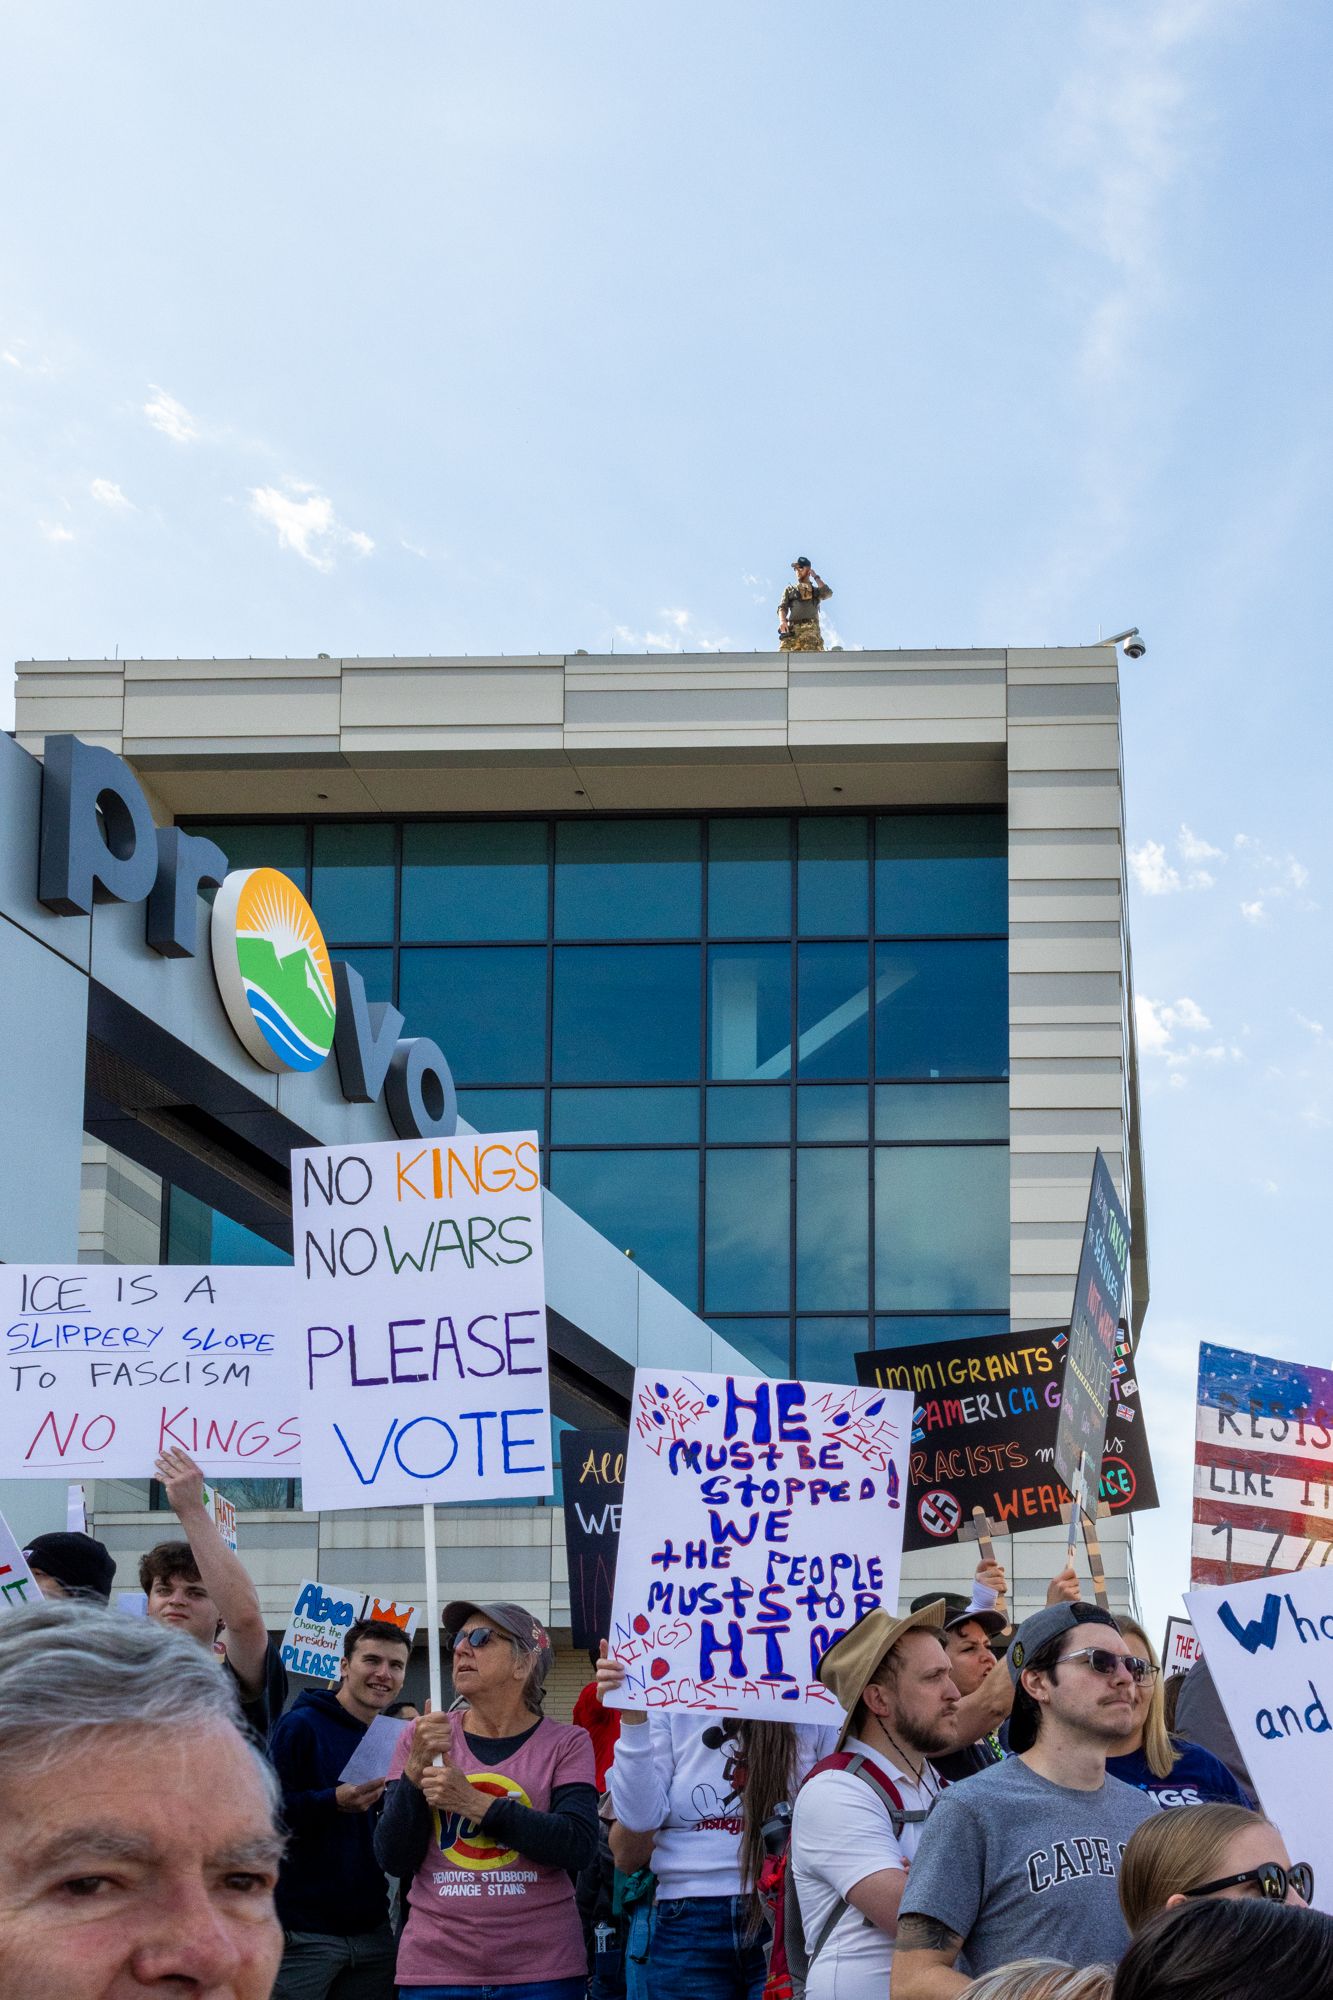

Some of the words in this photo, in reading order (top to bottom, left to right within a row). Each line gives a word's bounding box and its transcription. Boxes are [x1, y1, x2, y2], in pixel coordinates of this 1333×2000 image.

[303, 1156, 373, 1207] NO
[396, 1142, 539, 1201] KINGS
[305, 1227, 378, 1279] NO
[383, 1216, 533, 1274] WARS
[20, 1274, 90, 1313] ICE
[117, 1275, 159, 1305] IS
[184, 1275, 217, 1304] A
[6, 1322, 164, 1350] SLIPPERY
[182, 1327, 274, 1353] SLOPE
[307, 1310, 543, 1390] PLEASE
[90, 1361, 251, 1388] FASCISM
[874, 1347, 1053, 1392] IMMIGRANTS
[723, 1376, 812, 1445] HE
[926, 1386, 1038, 1431] AMERICA
[1217, 1392, 1333, 1450] RESIS
[24, 1410, 116, 1461] NO
[159, 1406, 301, 1456] KINGS
[333, 1408, 545, 1485] VOTE
[822, 1425, 891, 1471] LIES
[797, 1441, 844, 1470] BE
[911, 1441, 1029, 1486] RACISTS
[1209, 1459, 1274, 1498] LIKE
[994, 1484, 1074, 1521] WEAK
[707, 1508, 793, 1547] WE
[766, 1550, 884, 1591] PEOPLE
[294, 1584, 354, 1627] Alexa
[293, 1617, 326, 1638] Change
[329, 1626, 342, 1639] the
[293, 1632, 338, 1650] president
[612, 1618, 693, 1665] KINGS
[616, 1613, 650, 1644] NO
[1176, 1635, 1195, 1660] THE
[281, 1645, 340, 1679] PLEASE
[1256, 1680, 1333, 1740] and
[433, 1871, 475, 1884] REMOVES
[481, 1871, 538, 1882] STUBBORN
[1026, 1836, 1116, 1894] CAPE
[439, 1884, 482, 1897] ORANGE
[488, 1883, 526, 1895] STAINS
